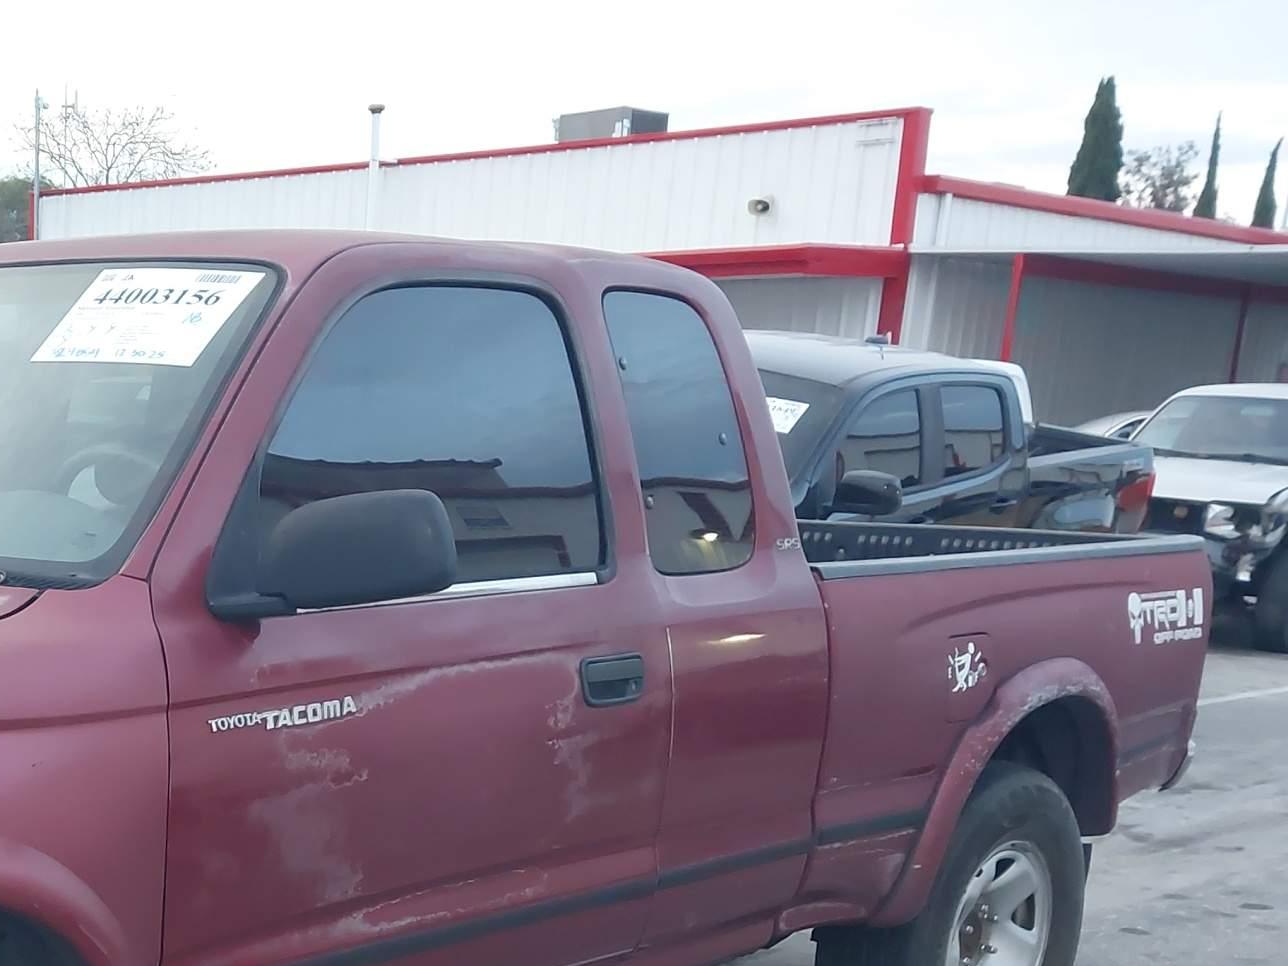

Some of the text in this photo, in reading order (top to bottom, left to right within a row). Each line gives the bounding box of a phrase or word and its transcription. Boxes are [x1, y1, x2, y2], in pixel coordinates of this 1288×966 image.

[94, 288, 226, 305] 44003156
[208, 696, 357, 733] TOYOTA TACOMA
